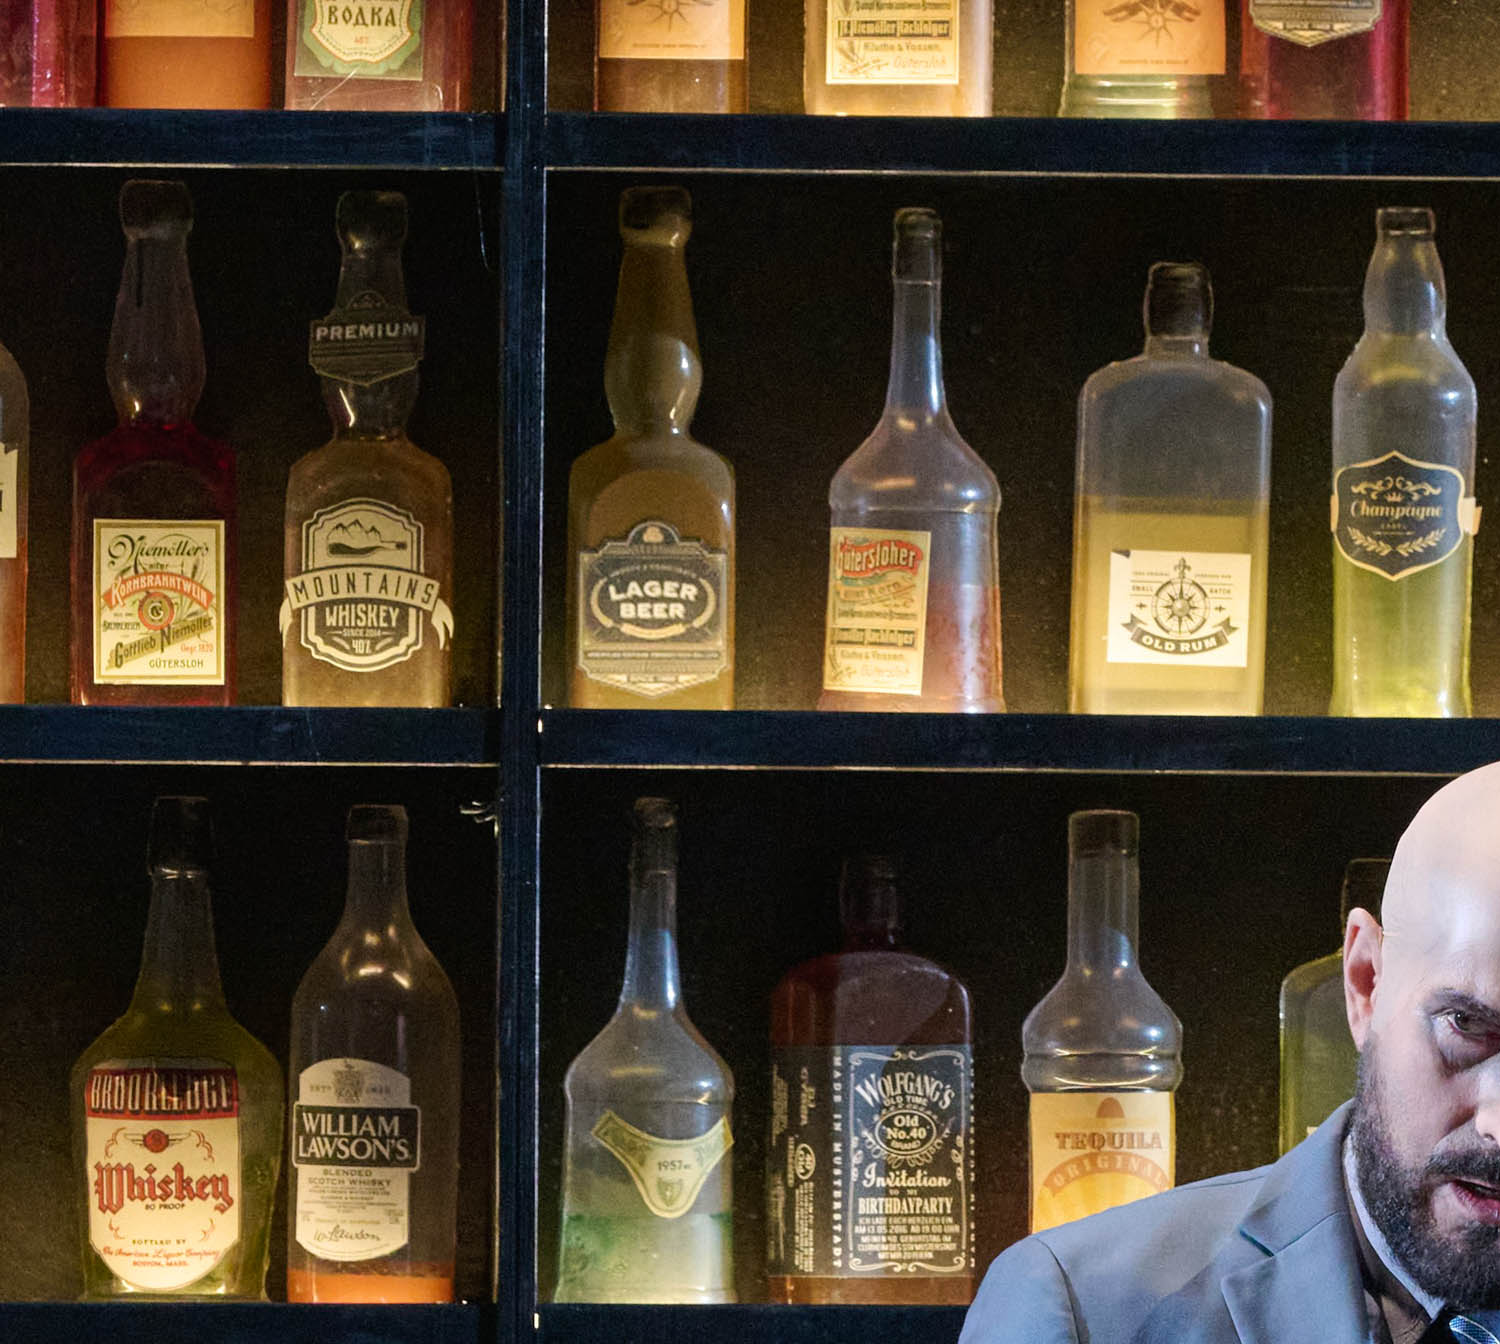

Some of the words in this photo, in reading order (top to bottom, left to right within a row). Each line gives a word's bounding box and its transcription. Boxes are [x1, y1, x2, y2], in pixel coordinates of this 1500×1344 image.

[327, 5, 397, 27] ВОДКА
[316, 322, 419, 341] PREMIUM
[1351, 500, 1442, 520] Champagne
[292, 571, 436, 604] MOUNTAINS
[608, 581, 698, 601] LAGER
[325, 604, 399, 628] WHISKEY
[619, 602, 686, 619] BEER
[114, 636, 156, 668] Gottlieb
[1141, 635, 1176, 652] OLD
[1179, 637, 1217, 652] RUM
[149, 658, 204, 668] GÜTERSLOH
[855, 1072, 955, 1109] WOLFGANG'S
[302, 1112, 400, 1137] WILLIAM
[894, 1115, 919, 1127] Old
[299, 1136, 409, 1160] LAWSON'S
[1054, 1132, 1162, 1150] TEQUILA
[308, 1177, 345, 1185] SCOTCH
[349, 1178, 392, 1187] WHISKY
[323, 1169, 373, 1177] BLENDED
[862, 1162, 952, 1189] Invitation
[94, 1162, 234, 1214] Whiskey
[858, 1197, 953, 1214] BIRTHDAYPARTY
